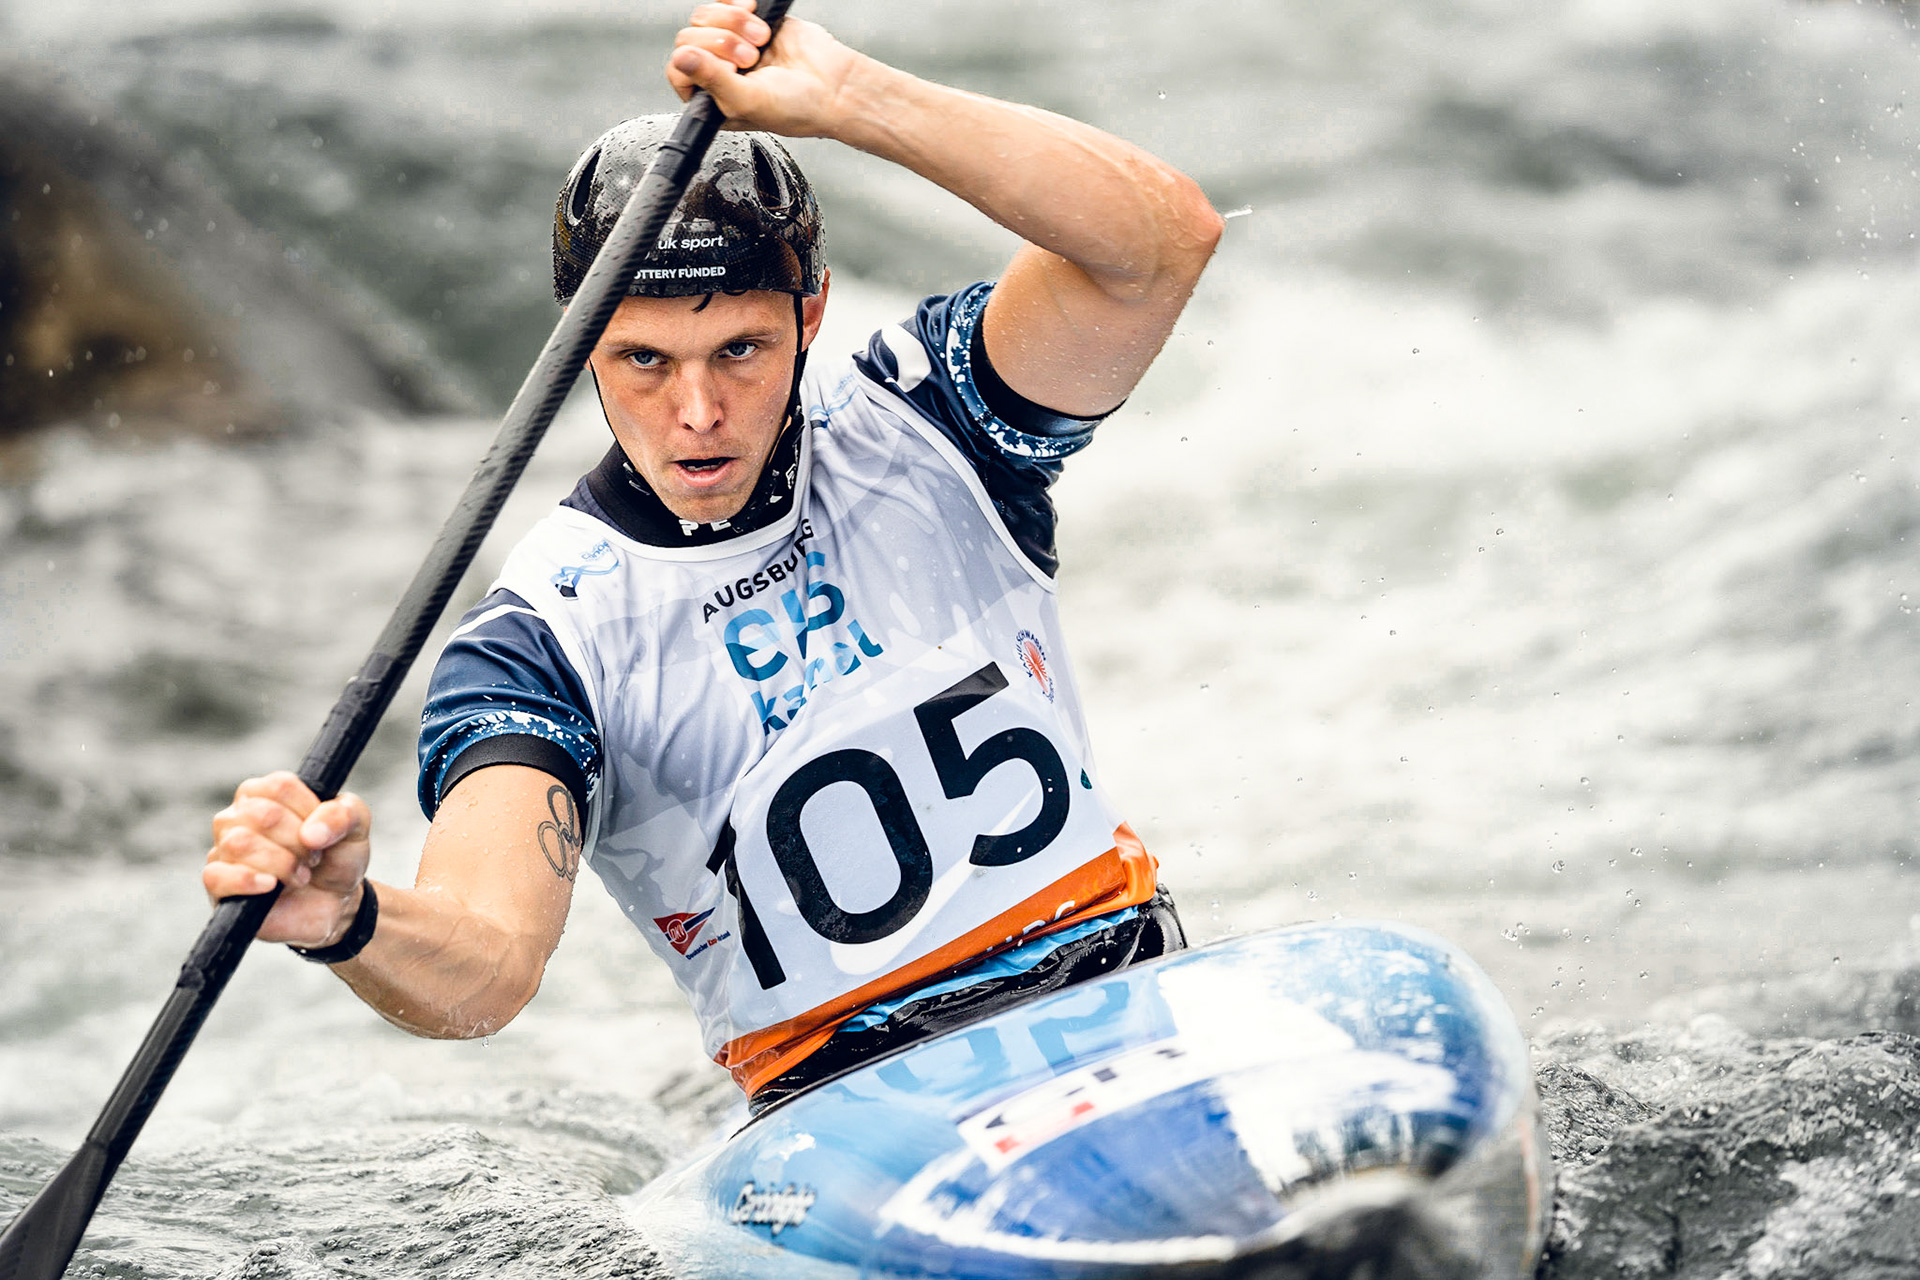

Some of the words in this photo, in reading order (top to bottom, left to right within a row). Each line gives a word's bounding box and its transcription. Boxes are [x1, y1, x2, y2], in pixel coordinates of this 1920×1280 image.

[658, 237, 677, 250] uk
[680, 235, 724, 251] sport
[678, 266, 726, 279] FUNDED
[706, 661, 1070, 990] 105
